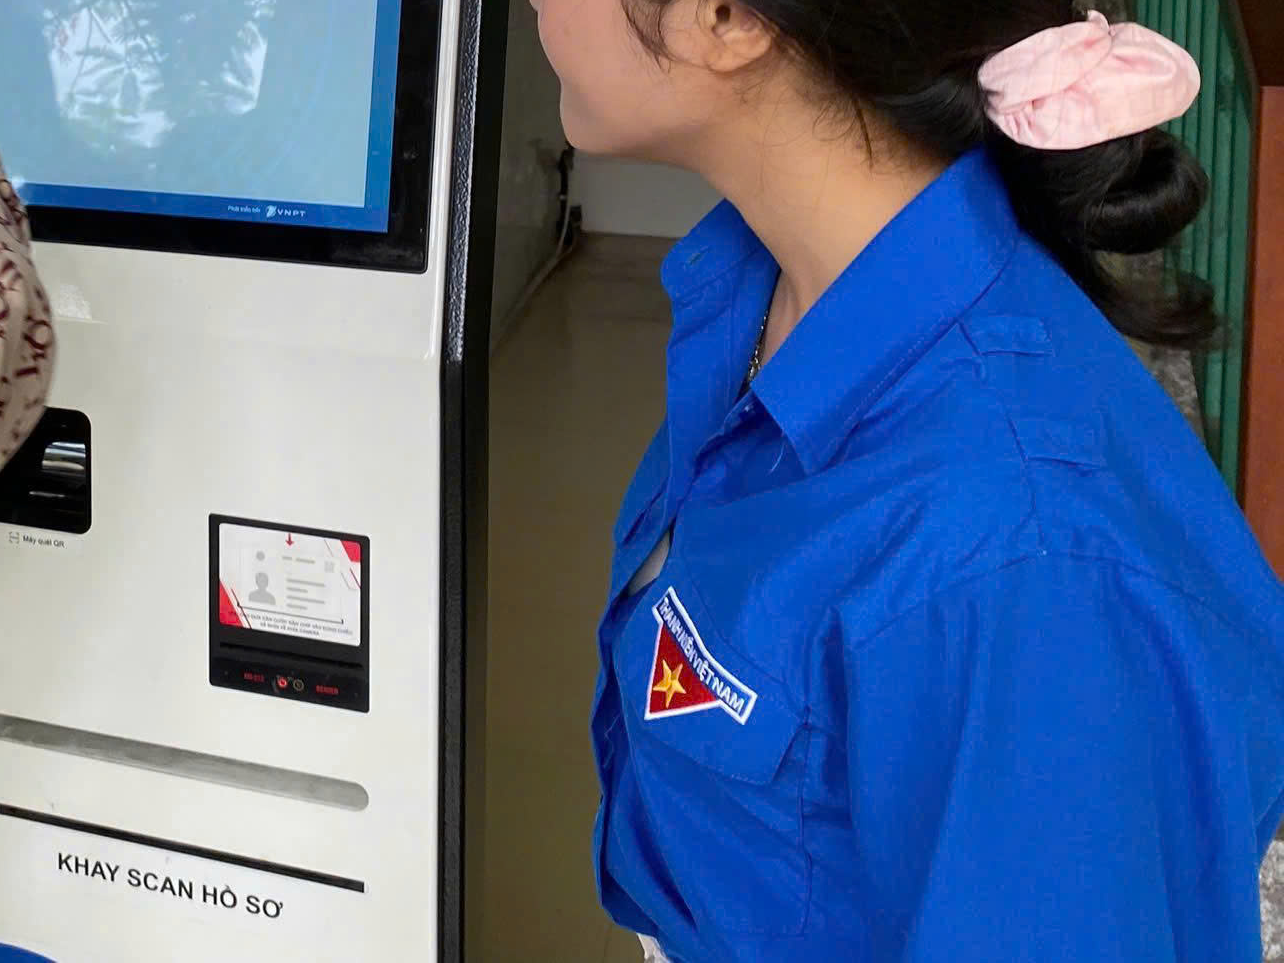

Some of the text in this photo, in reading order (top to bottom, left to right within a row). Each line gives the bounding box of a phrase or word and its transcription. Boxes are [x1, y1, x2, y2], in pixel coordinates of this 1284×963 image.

[277, 208, 306, 218] VNPT
[712, 677, 745, 714] NAM
[58, 852, 284, 919] KHAY SCAN HỒ SƠ
